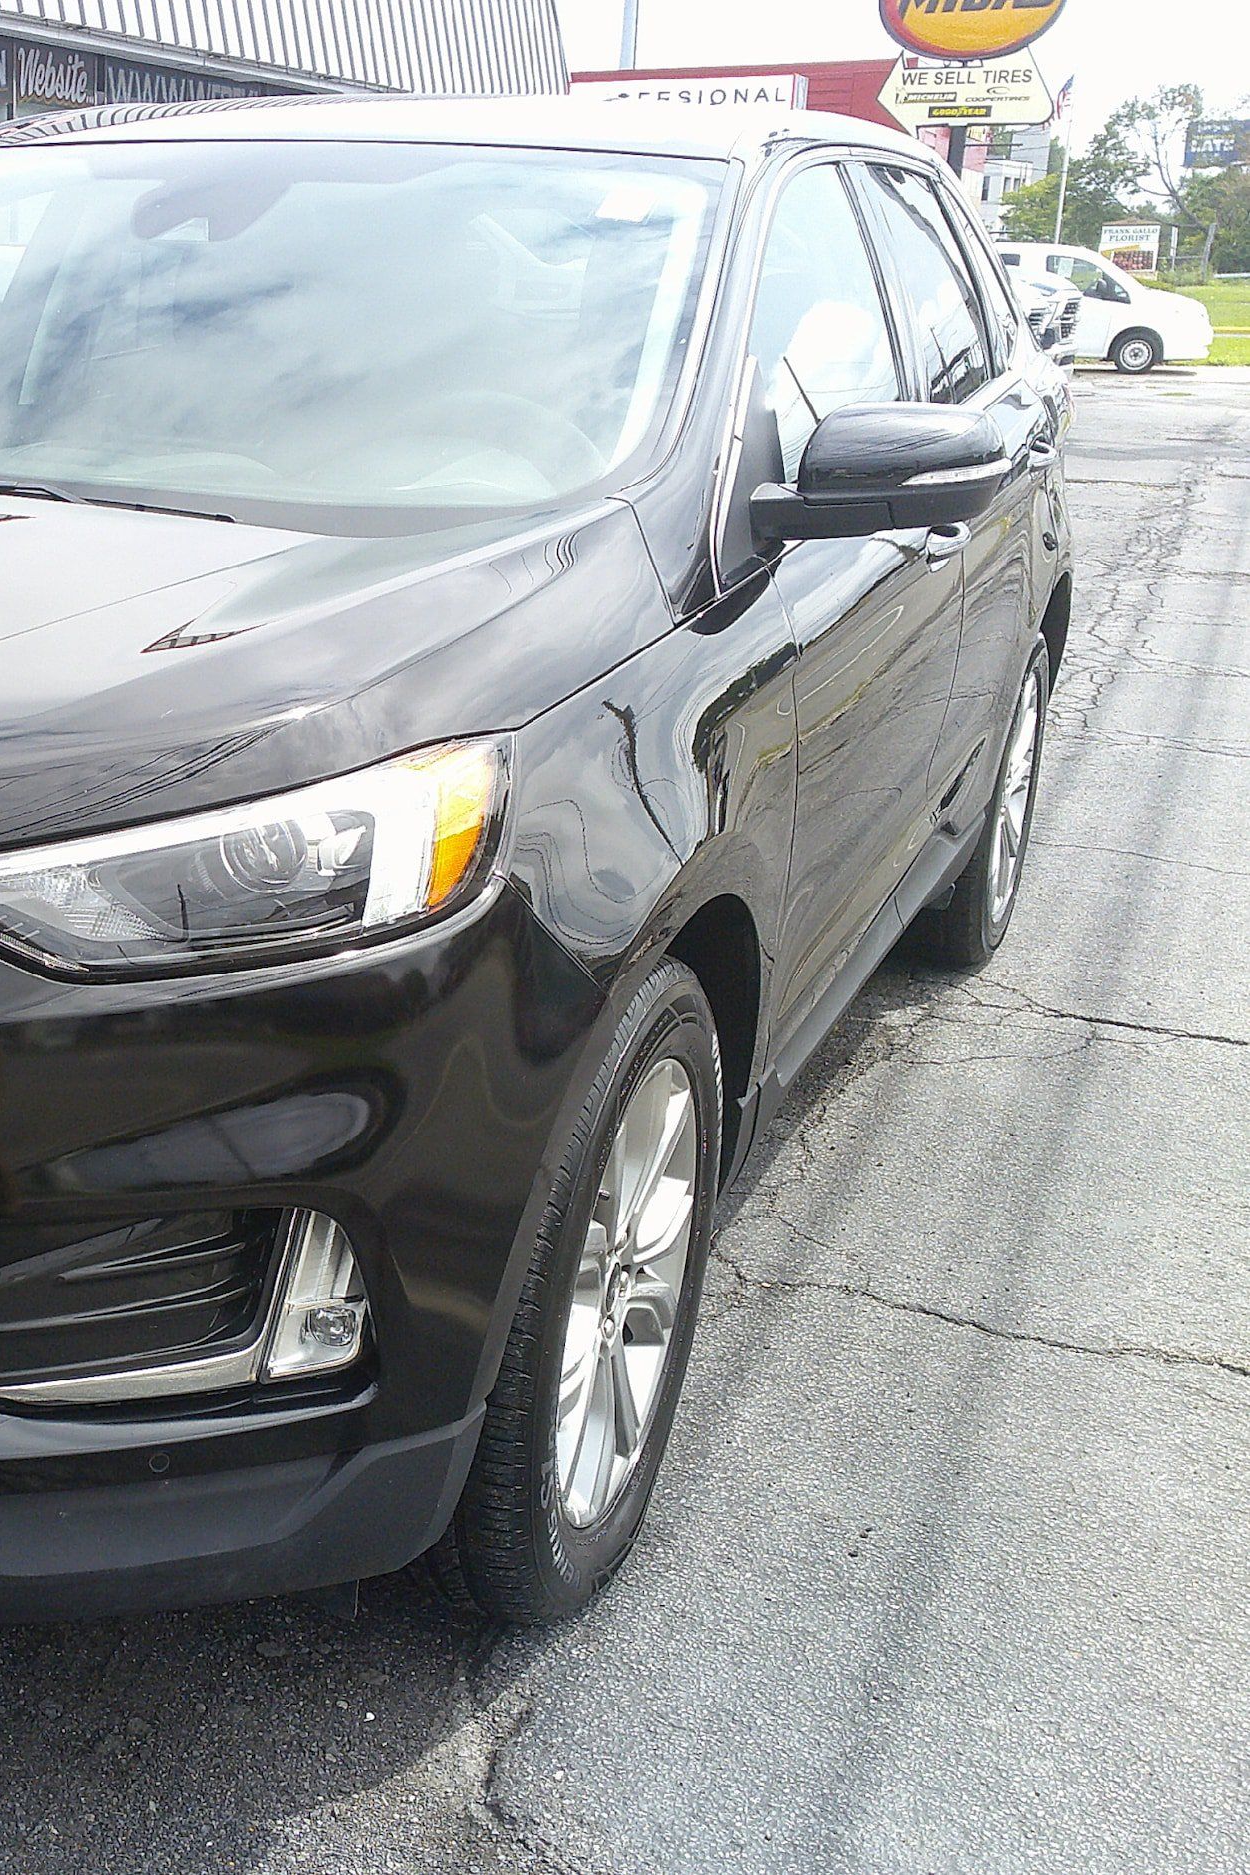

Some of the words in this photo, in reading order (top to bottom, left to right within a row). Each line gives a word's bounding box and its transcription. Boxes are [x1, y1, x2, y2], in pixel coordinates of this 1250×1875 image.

[902, 72, 928, 86] WE
[934, 71, 976, 85] SELL
[983, 69, 1033, 84] TIRES
[907, 92, 957, 102] MICHELIN
[932, 105, 987, 117] GOODYEAR
[1109, 234, 1151, 242] FLORIST
